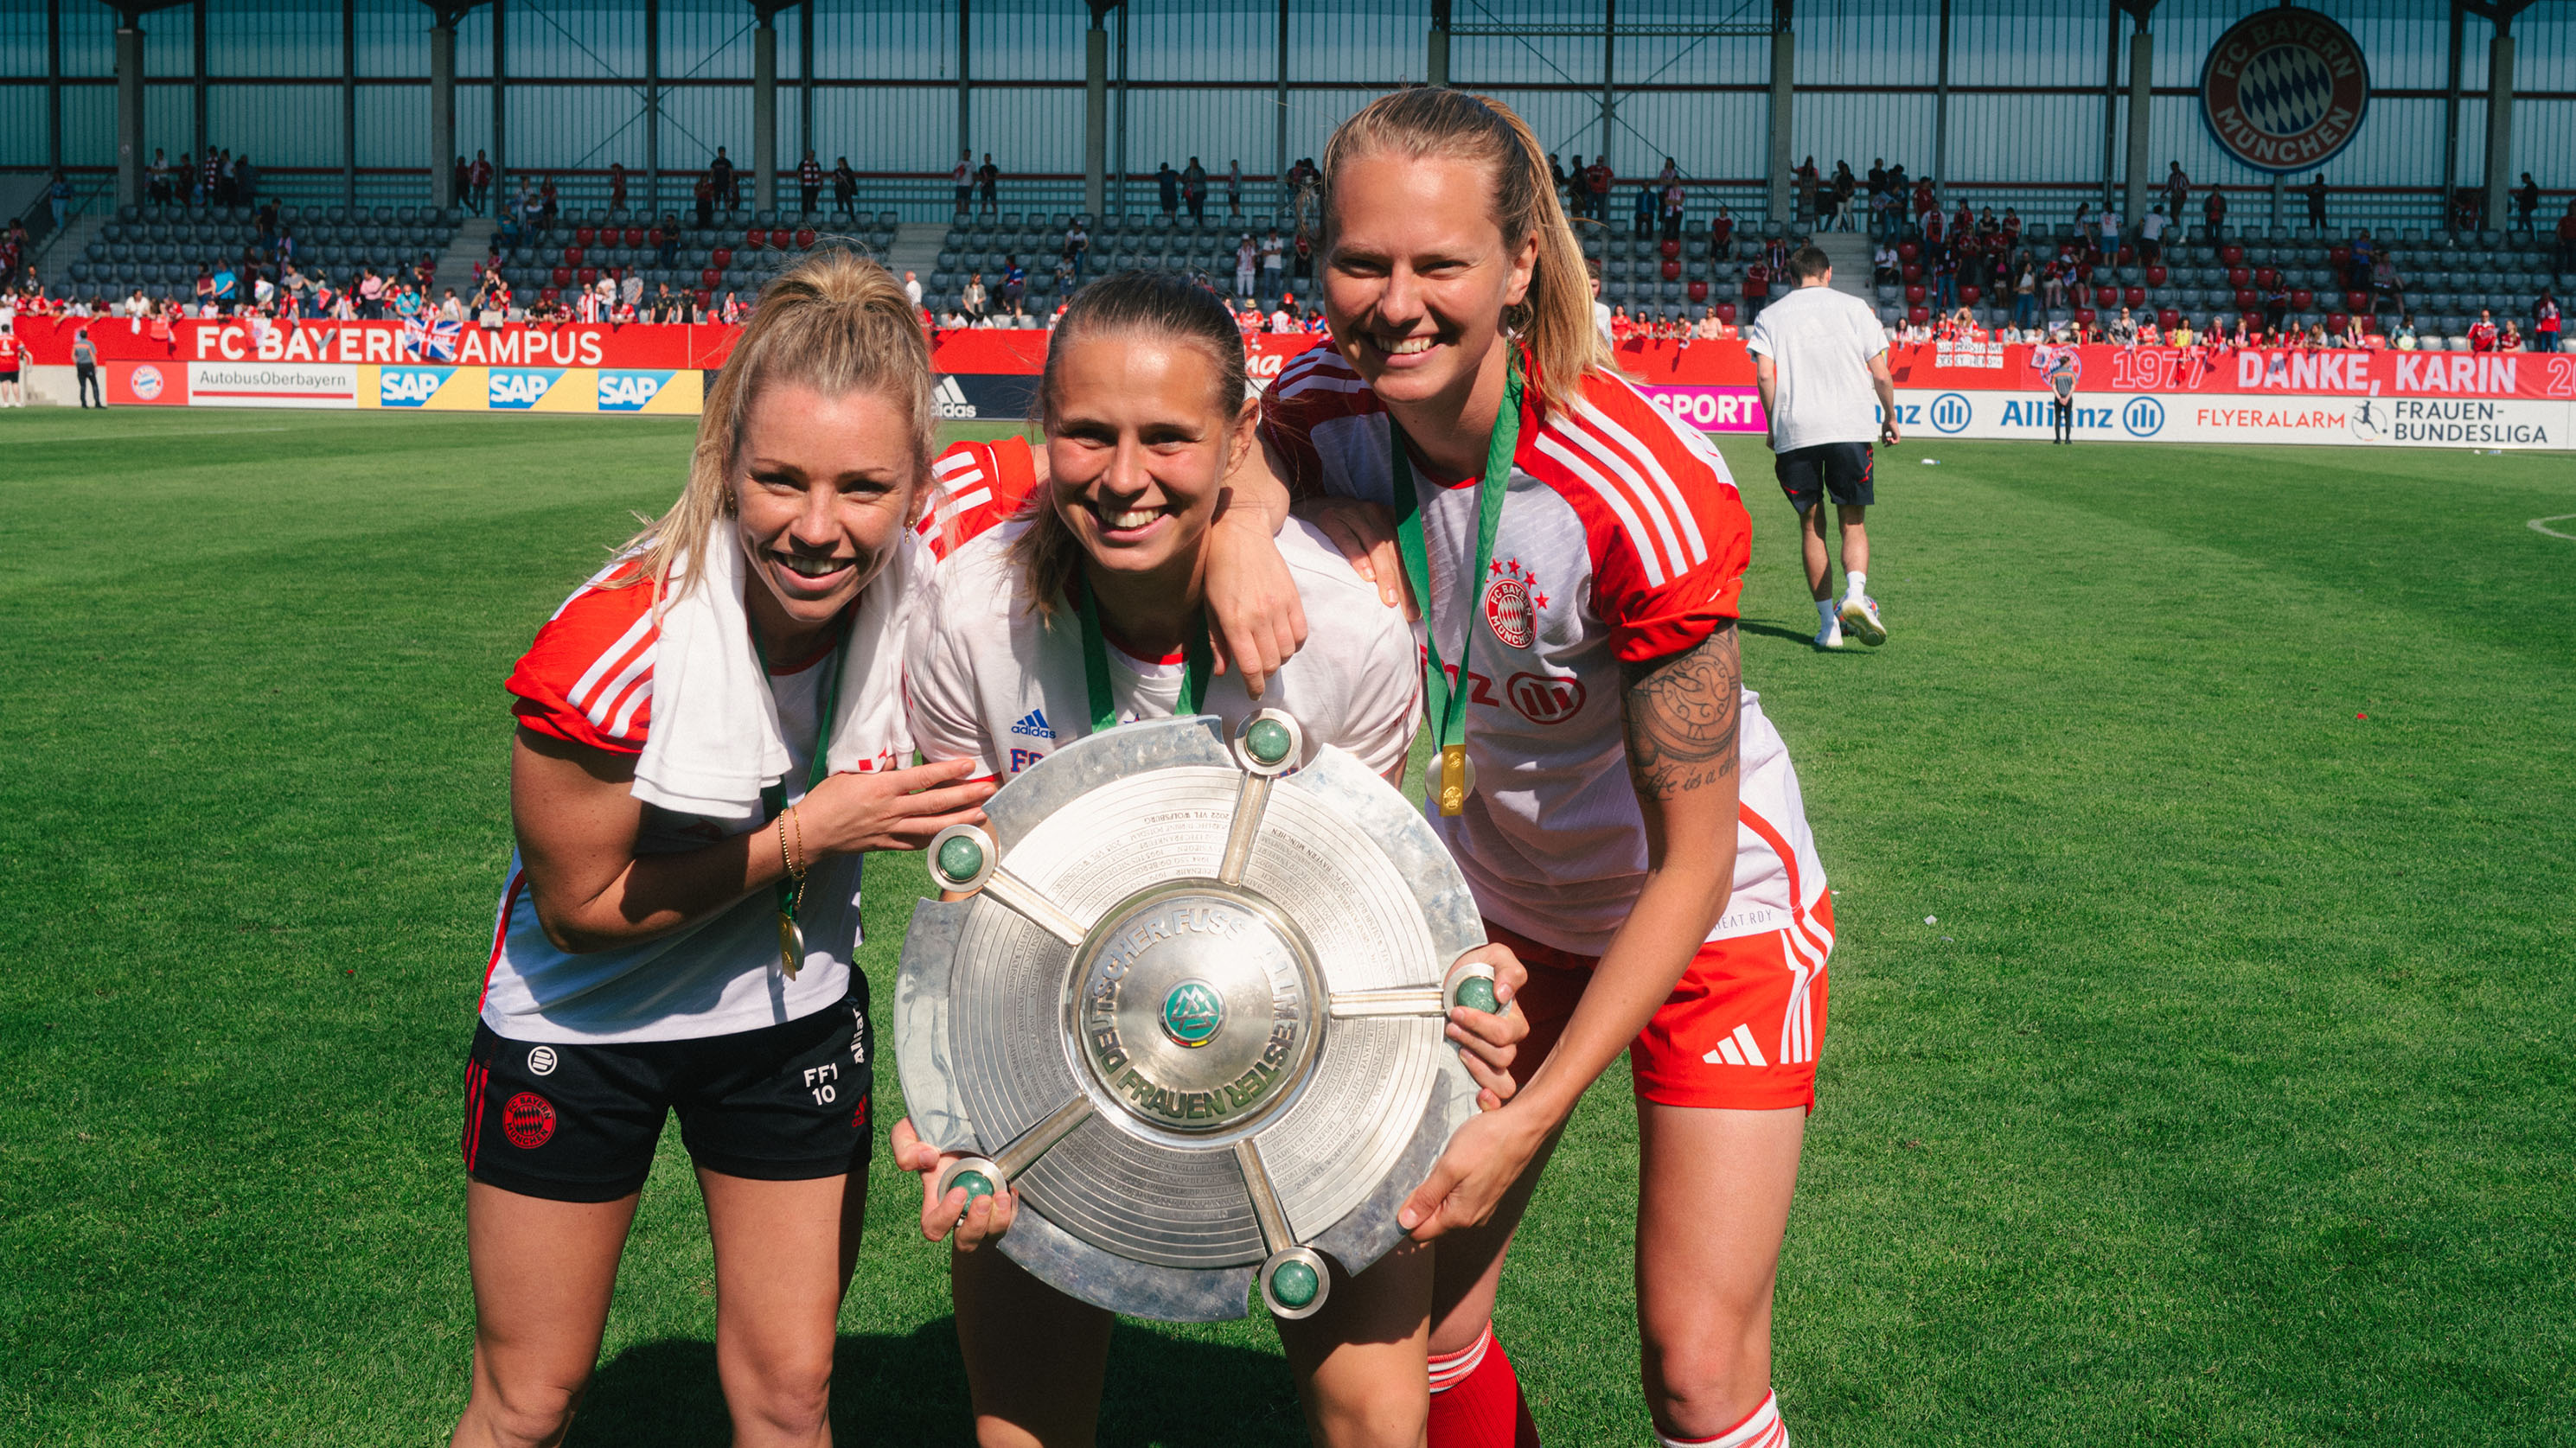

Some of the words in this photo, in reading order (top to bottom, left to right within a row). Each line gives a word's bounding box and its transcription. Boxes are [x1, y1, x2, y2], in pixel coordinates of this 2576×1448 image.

[2216, 41, 2248, 79] FC
[2250, 20, 2356, 79] BAYERN
[2216, 106, 2353, 163] MÜNCHEN
[196, 326, 246, 360] FC
[451, 330, 603, 365] AMPUS
[200, 370, 346, 388] AutobusOberbayern
[380, 373, 440, 401] SAP
[2113, 349, 2208, 389] 1977
[2238, 351, 2381, 397] DANKE,
[2395, 354, 2517, 394] KARIN
[489, 373, 549, 403] SAP
[598, 376, 658, 405] SAP
[2000, 400, 2113, 428] Allinz
[2197, 408, 2345, 429] FLYERALARM
[2394, 401, 2504, 420] FRAUEN-
[2394, 423, 2548, 443] BUNDESLIGA
[1491, 589, 1503, 605] FC
[1501, 584, 1533, 616] BAYERN
[1011, 724, 1057, 739] adidas
[1142, 811, 1191, 826] WOLFSBURG
[1304, 847, 1334, 872] BAYERN
[1330, 869, 1344, 882] FC
[1749, 909, 1772, 925] RDY
[1028, 967, 1041, 998] SIEGEN
[802, 1062, 839, 1088] FF1
[1032, 1052, 1057, 1098] FRANKFURT
[1309, 1076, 1338, 1115] BERGISCH
[1332, 1032, 1352, 1078] GLADBACH
[811, 1084, 837, 1107] 10
[1115, 1067, 1228, 1119] FRAUEN
[1265, 1134, 1307, 1166] GLADBACH
[1335, 1058, 1358, 1096] BERGISCH
[1350, 1018, 1364, 1059] GLADBACH
[1300, 1119, 1338, 1157] FRANKFURT
[1357, 1027, 1374, 1075] FRANKFURT
[520, 1096, 553, 1120] BAYERN
[1257, 1127, 1277, 1144] 1976
[1274, 1120, 1287, 1133] FC
[1282, 1098, 1310, 1126] BAYERN
[1308, 1126, 1347, 1164] FRANKFURT
[1323, 1126, 1362, 1169] WOLFSBURG
